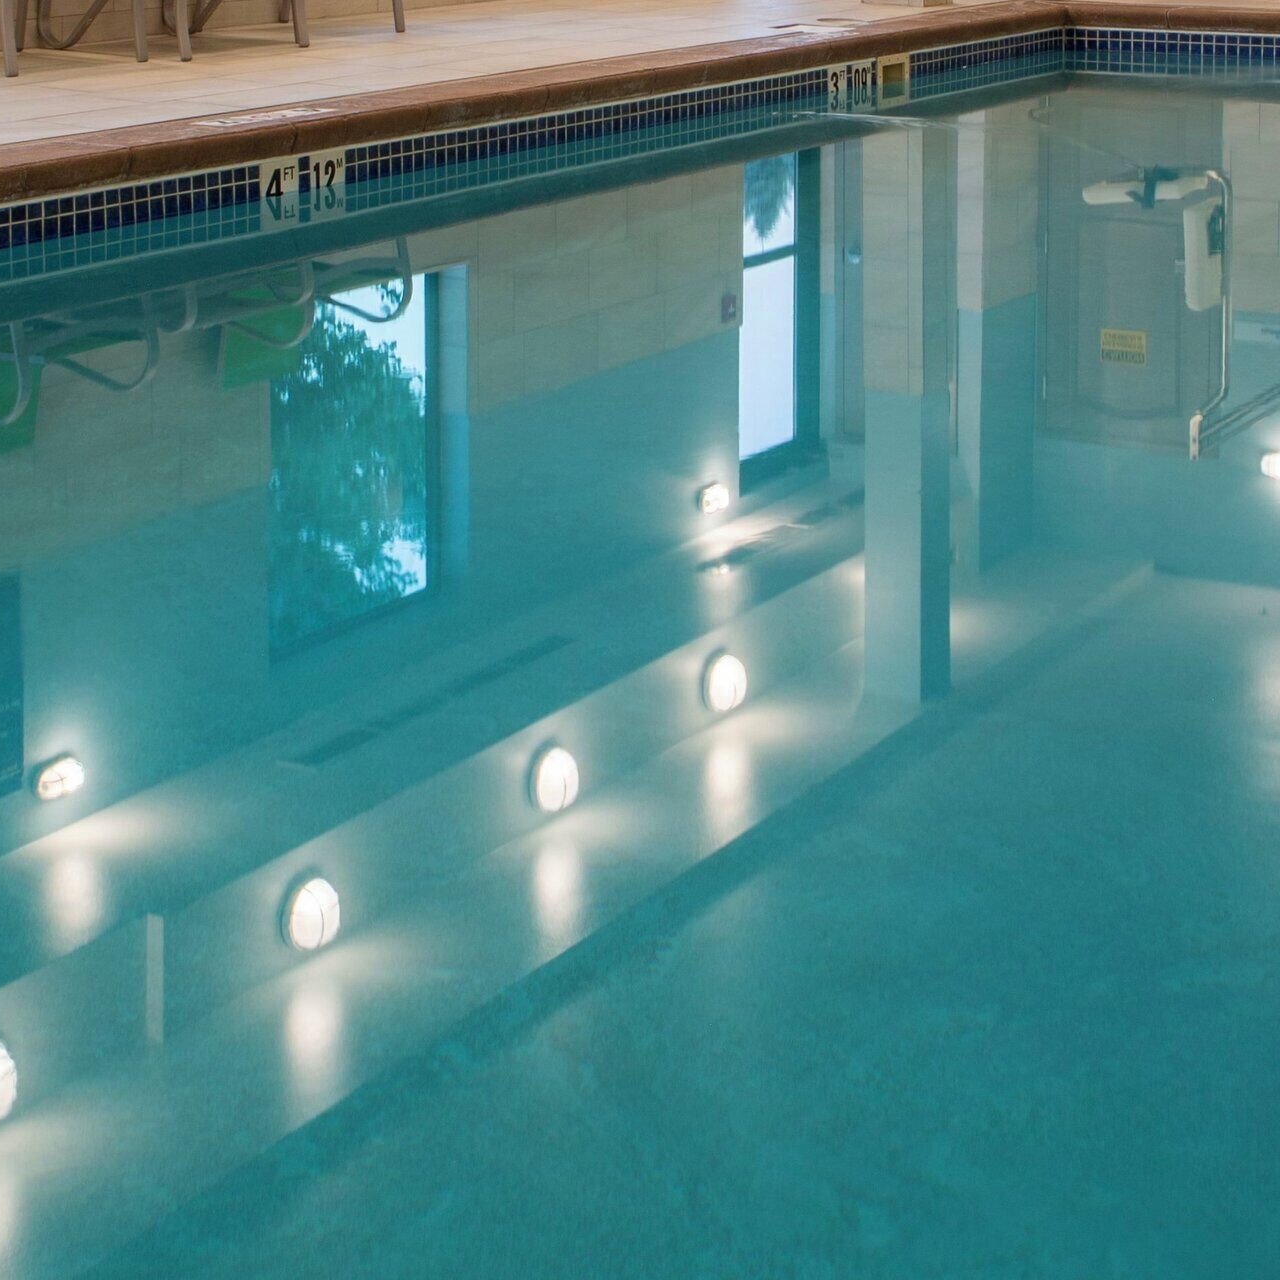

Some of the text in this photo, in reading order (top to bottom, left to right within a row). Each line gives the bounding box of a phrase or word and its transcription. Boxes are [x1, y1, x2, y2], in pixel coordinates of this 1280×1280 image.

[830, 71, 839, 94] 3
[265, 168, 284, 197] 4
[283, 166, 296, 181] FT
[336, 157, 344, 169] M
